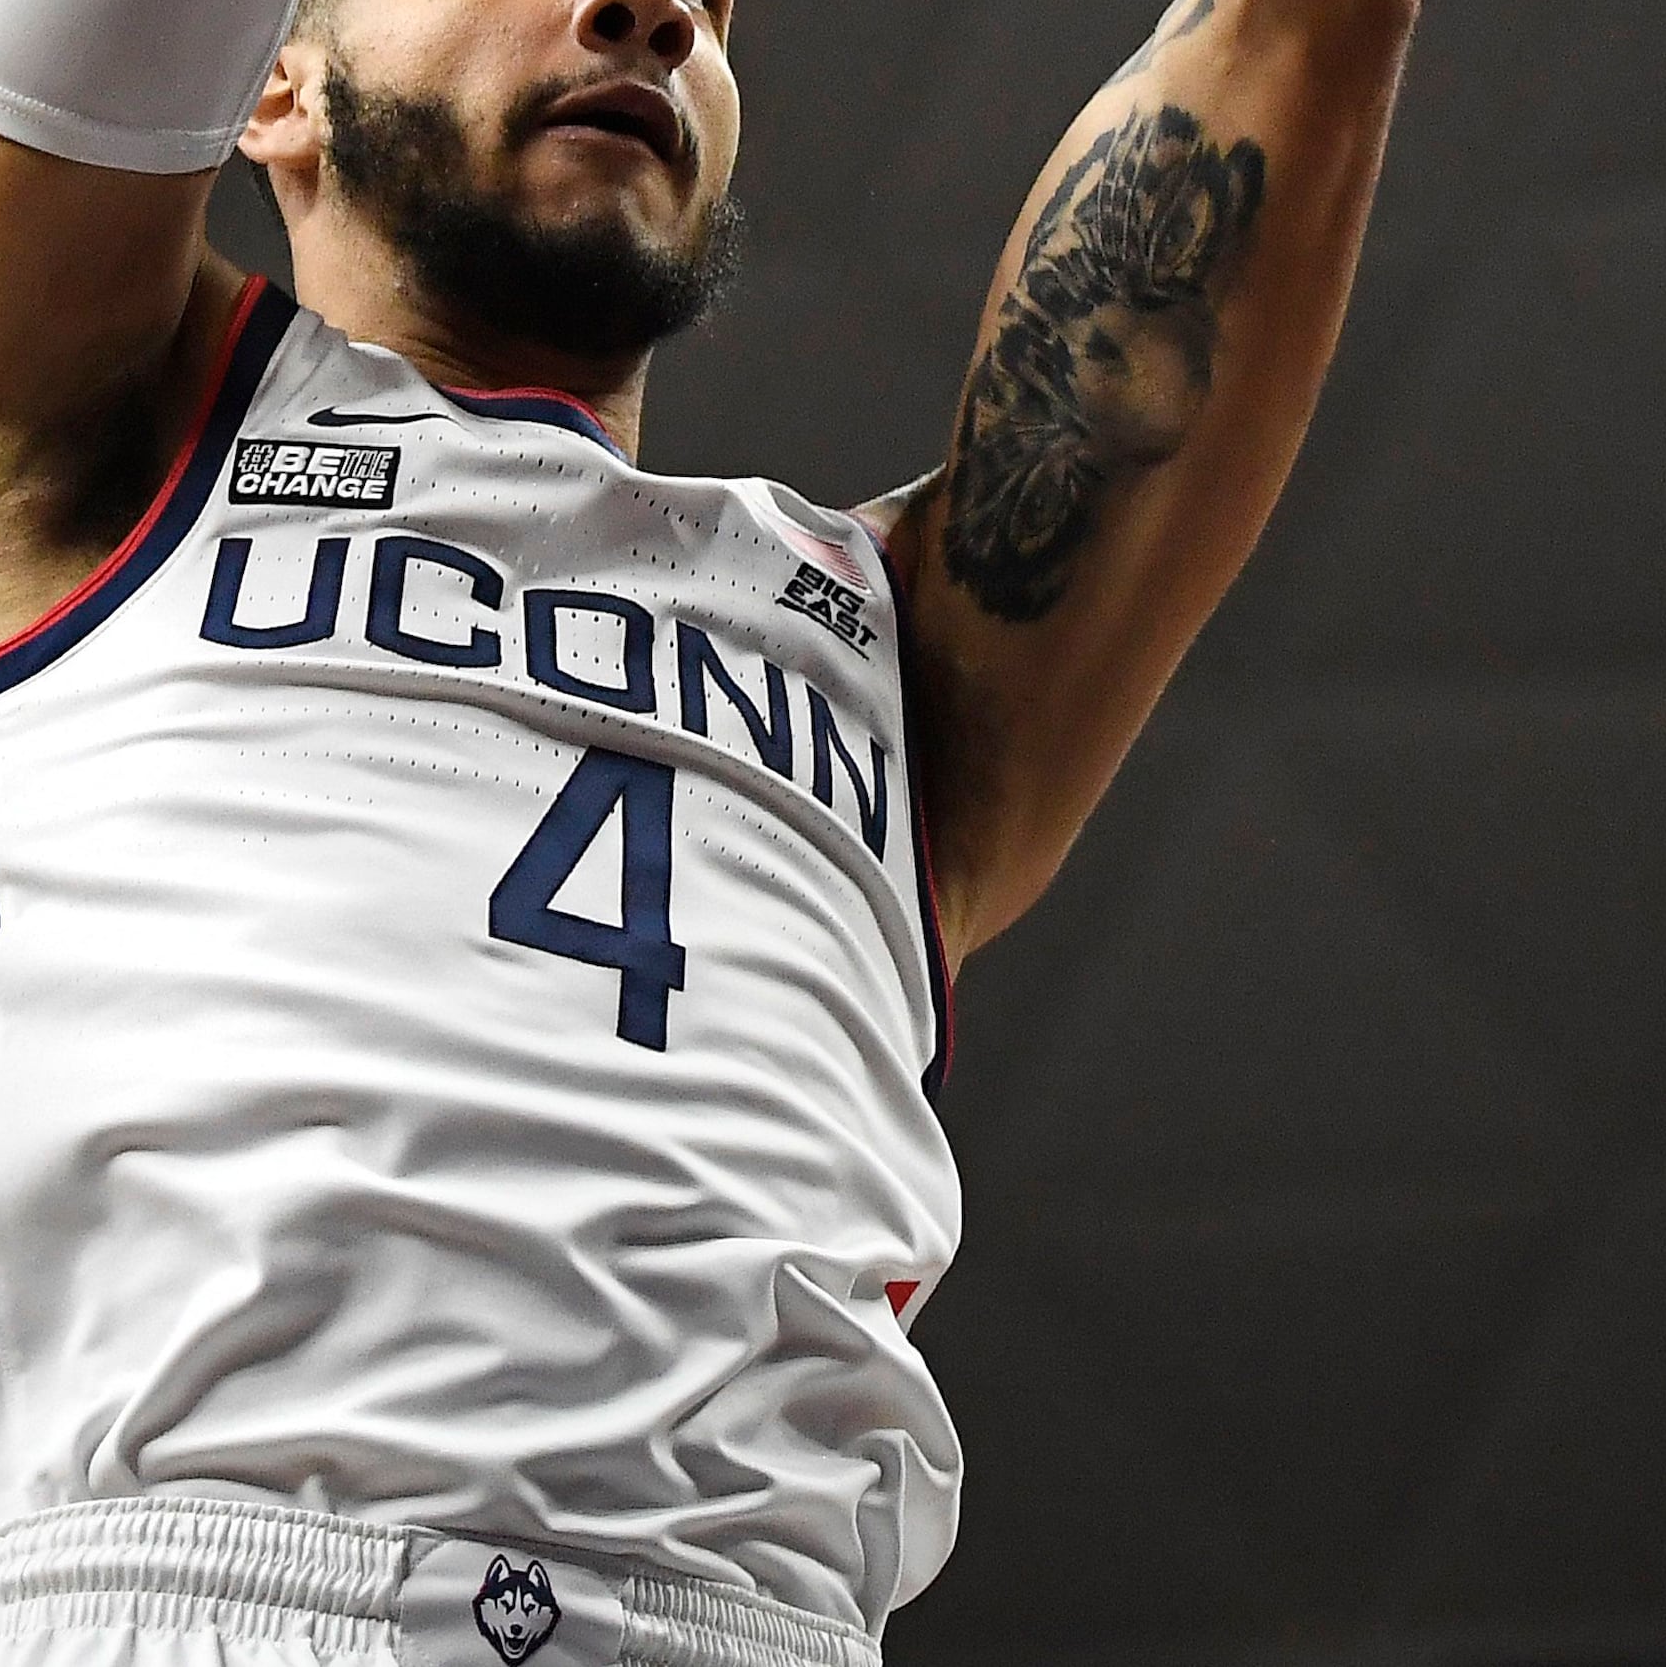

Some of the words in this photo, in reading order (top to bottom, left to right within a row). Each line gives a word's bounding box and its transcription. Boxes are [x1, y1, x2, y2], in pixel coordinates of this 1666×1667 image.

[236, 473, 388, 500] CHANGE
[784, 579, 878, 646] EAST
[795, 562, 865, 615] BIG
[199, 537, 886, 865] UCONN
[488, 746, 685, 1052] 4
